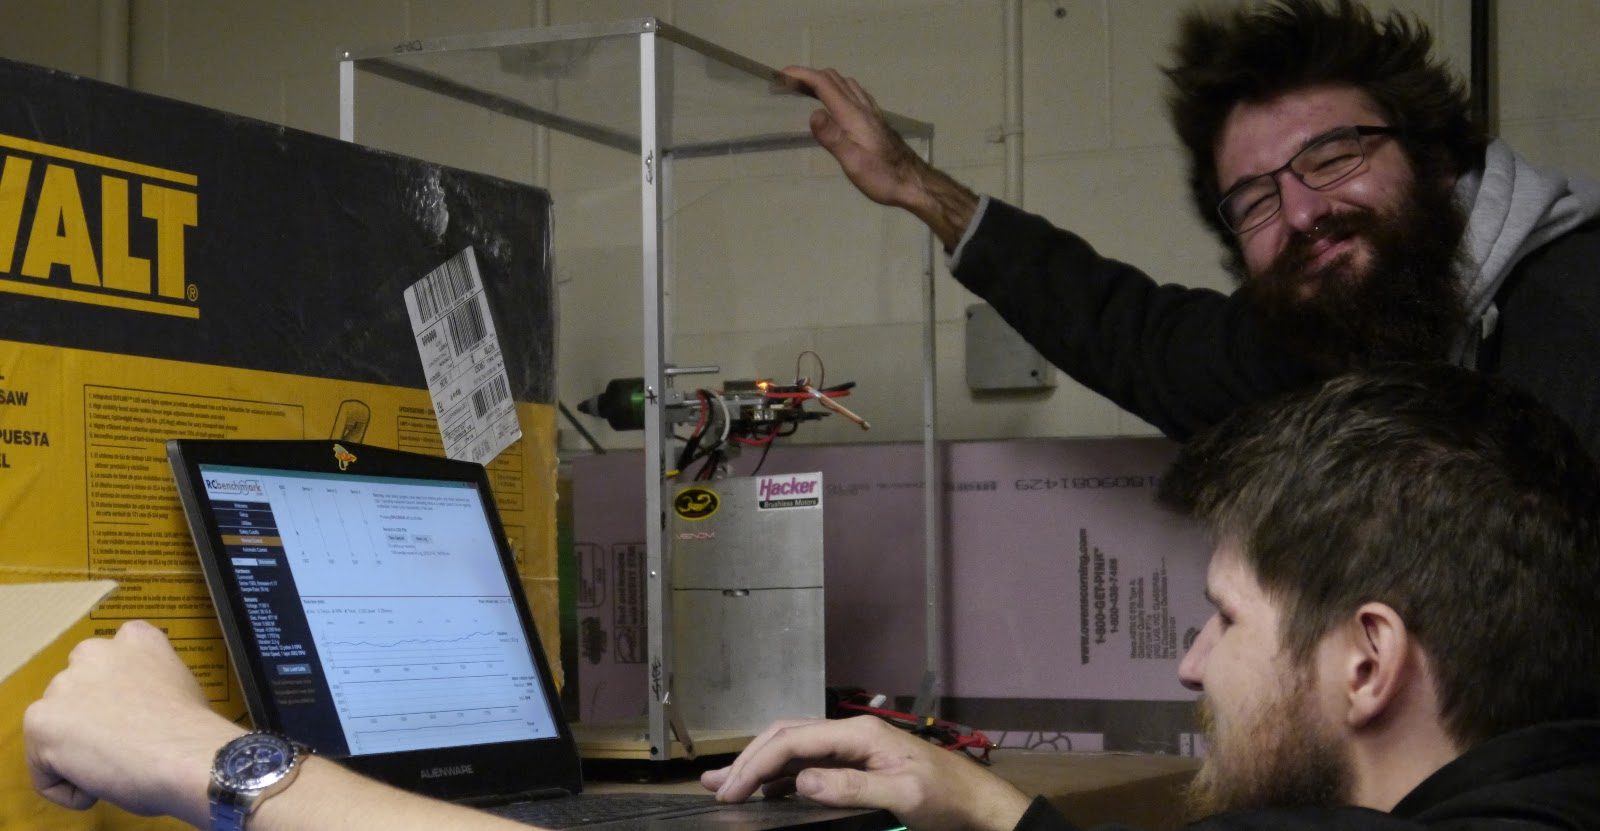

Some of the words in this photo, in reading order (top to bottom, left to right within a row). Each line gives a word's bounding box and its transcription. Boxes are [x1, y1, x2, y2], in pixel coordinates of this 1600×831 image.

[0, 428, 50, 448] UESTA
[759, 476, 818, 502] Hacker
[763, 500, 794, 509] Brushless
[794, 498, 818, 507] Motors
[420, 764, 474, 778] ALIENWARE
